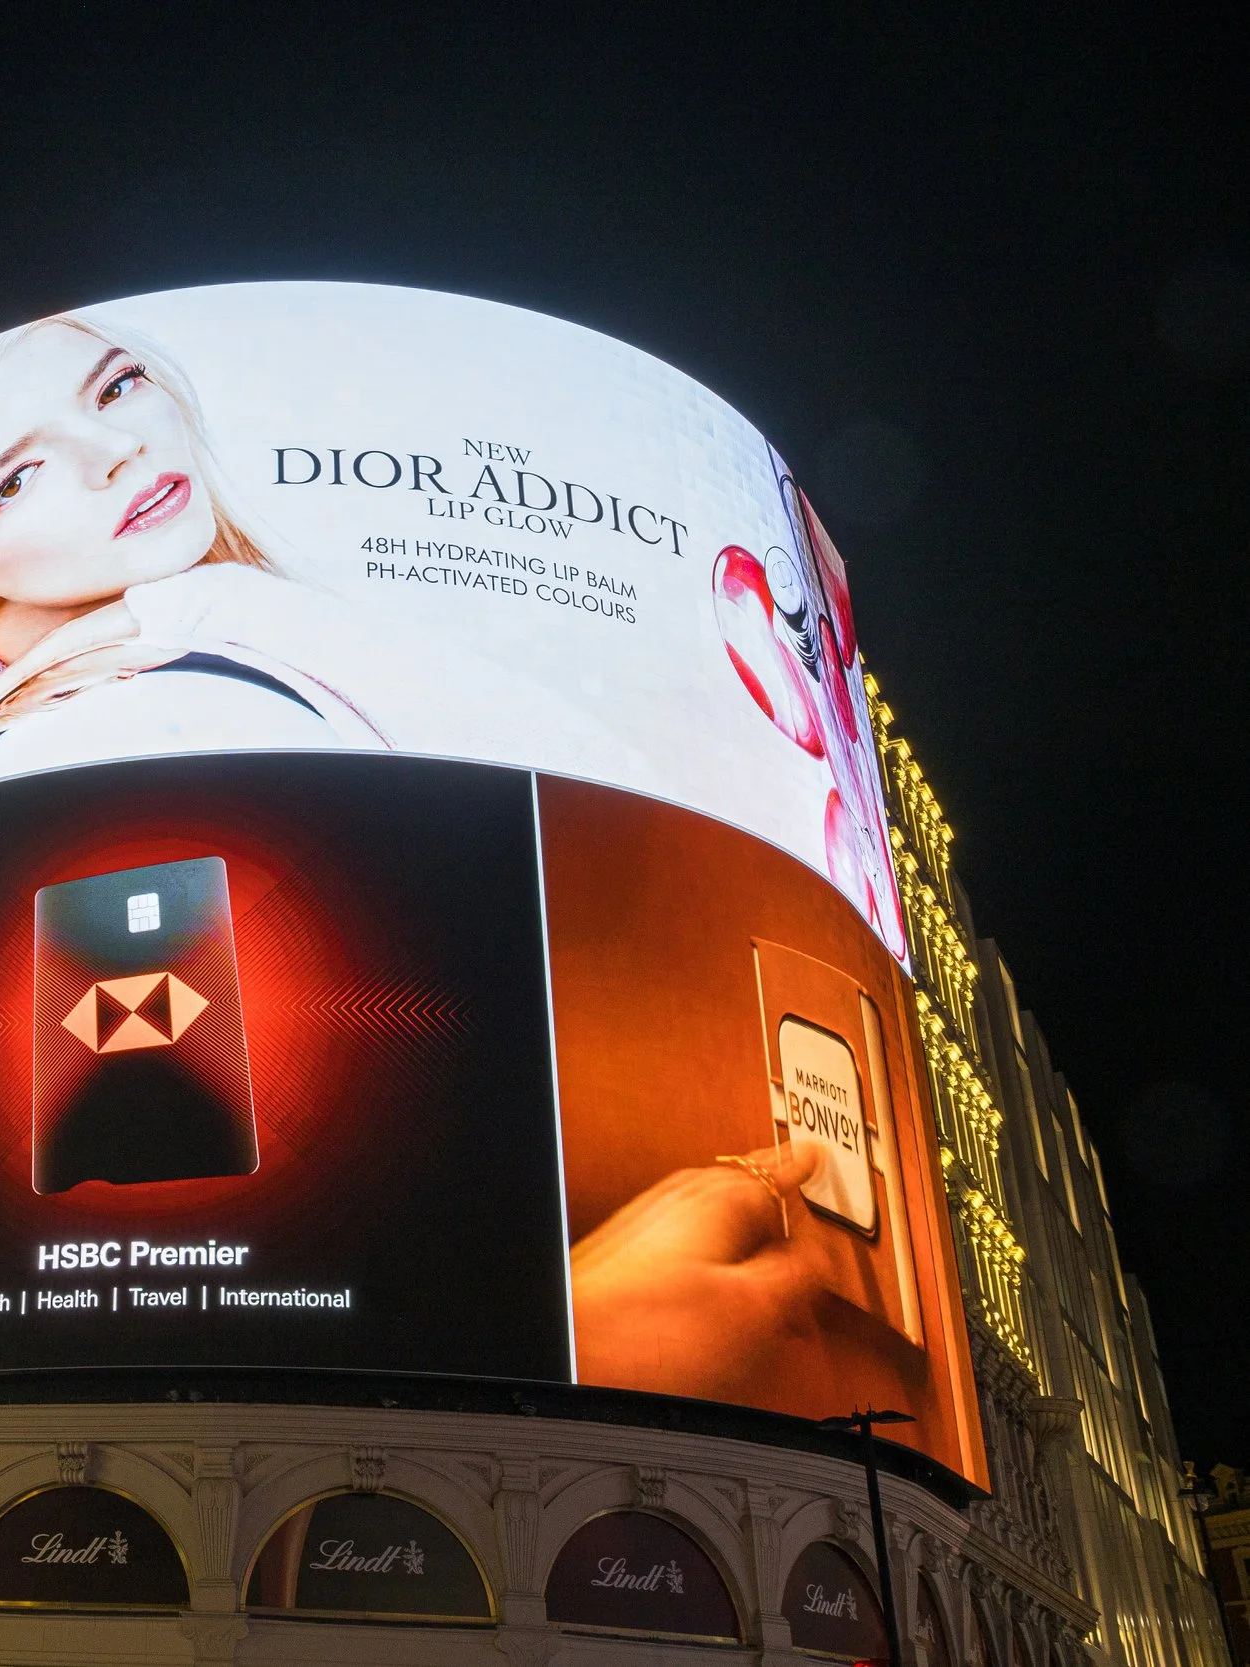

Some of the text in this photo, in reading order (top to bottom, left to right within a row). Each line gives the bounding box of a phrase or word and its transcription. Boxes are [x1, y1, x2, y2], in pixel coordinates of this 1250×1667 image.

[462, 438, 532, 466] NEW
[271, 447, 689, 559] DIOR ADDICT
[427, 497, 574, 540] LIP GLOW
[360, 536, 637, 601] 48H HYDRATING LIP BALM
[366, 561, 636, 624] PH-ACTIVATED COLOURS
[795, 1067, 847, 1107] MARRIOTT
[789, 1090, 859, 1155] BONVOY
[37, 1238, 250, 1271] HSBC Premier
[37, 1288, 99, 1310] Health
[128, 1286, 188, 1308] Travel
[219, 1286, 351, 1309] International
[21, 1533, 108, 1564] Lindt
[309, 1540, 402, 1573] Lindt
[591, 1557, 667, 1592] Lindt
[803, 1584, 847, 1618] Lindt
